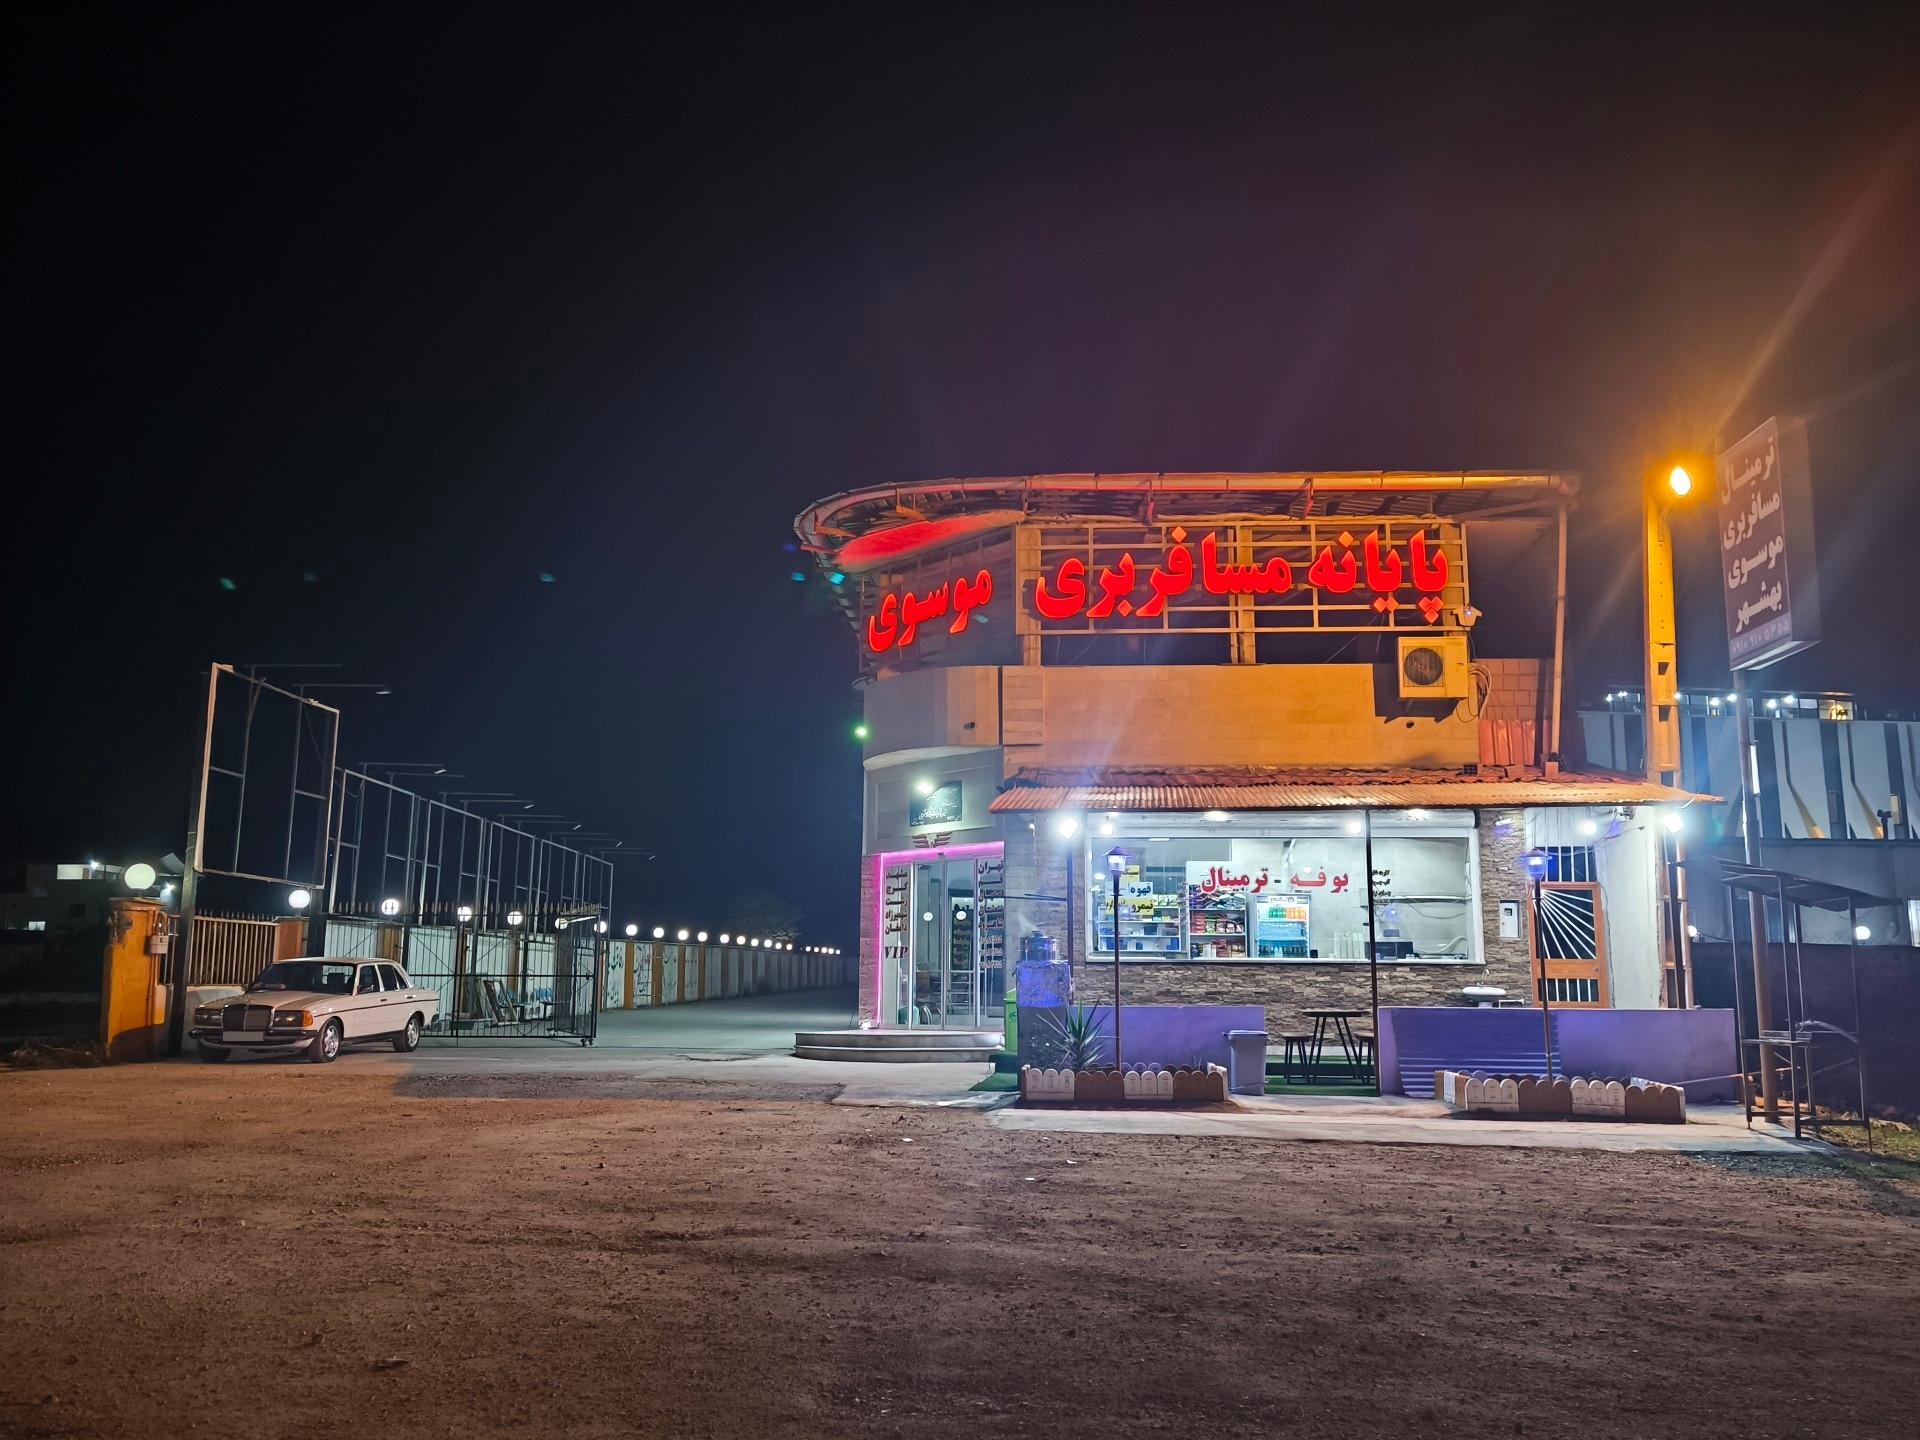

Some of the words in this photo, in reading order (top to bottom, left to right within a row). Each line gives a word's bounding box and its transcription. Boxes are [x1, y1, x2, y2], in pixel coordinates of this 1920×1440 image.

[1721, 436, 1775, 505] ترمینال
[1723, 491, 1781, 550] مسافربری
[1727, 534, 1784, 589] موسوی
[1309, 528, 1449, 624] پایانه
[868, 567, 994, 653] موسوی
[1735, 580, 1784, 634] بهشهر
[886, 868, 908, 880] مشهد
[978, 860, 1004, 874] تهران
[1201, 866, 1269, 893] ترمینال
[1290, 866, 1349, 893] بوفه
[885, 897, 908, 906] رشت
[886, 882, 908, 895] کرج
[1130, 882, 1152, 897] قهوه
[1131, 900, 1154, 913] نیمرو
[885, 946, 908, 959] VIP
